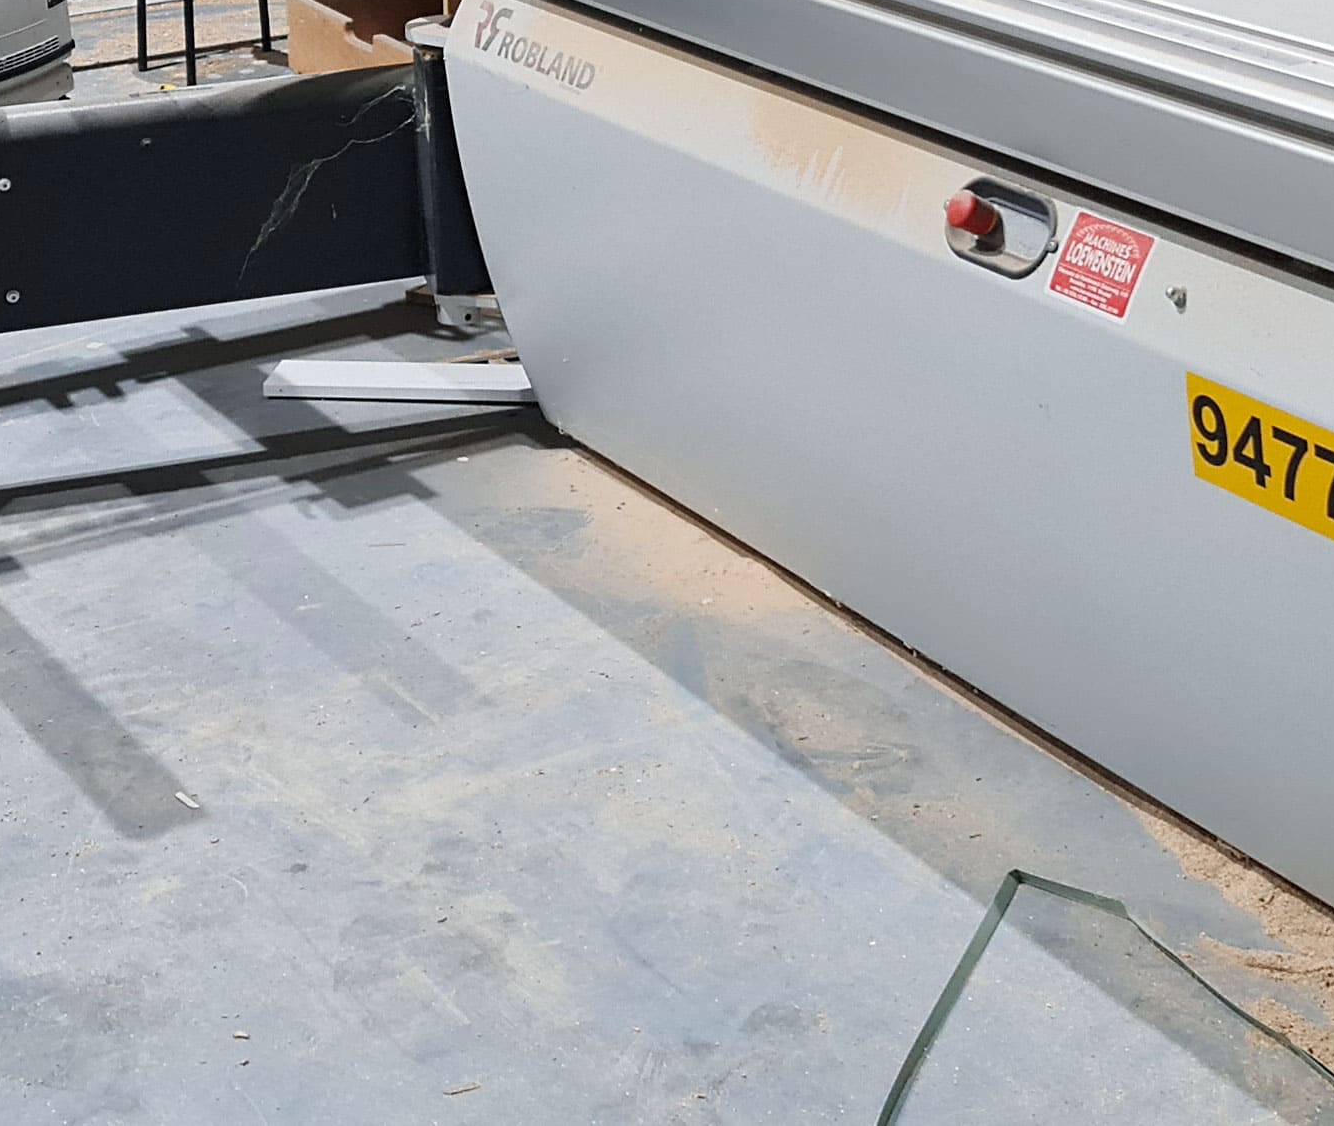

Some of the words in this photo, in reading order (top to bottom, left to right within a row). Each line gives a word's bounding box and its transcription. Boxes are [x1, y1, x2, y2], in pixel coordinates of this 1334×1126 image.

[497, 31, 597, 91] ROBLAND
[1065, 240, 1137, 284] LOEWENSTEIN
[1082, 232, 1133, 259] MACHINES
